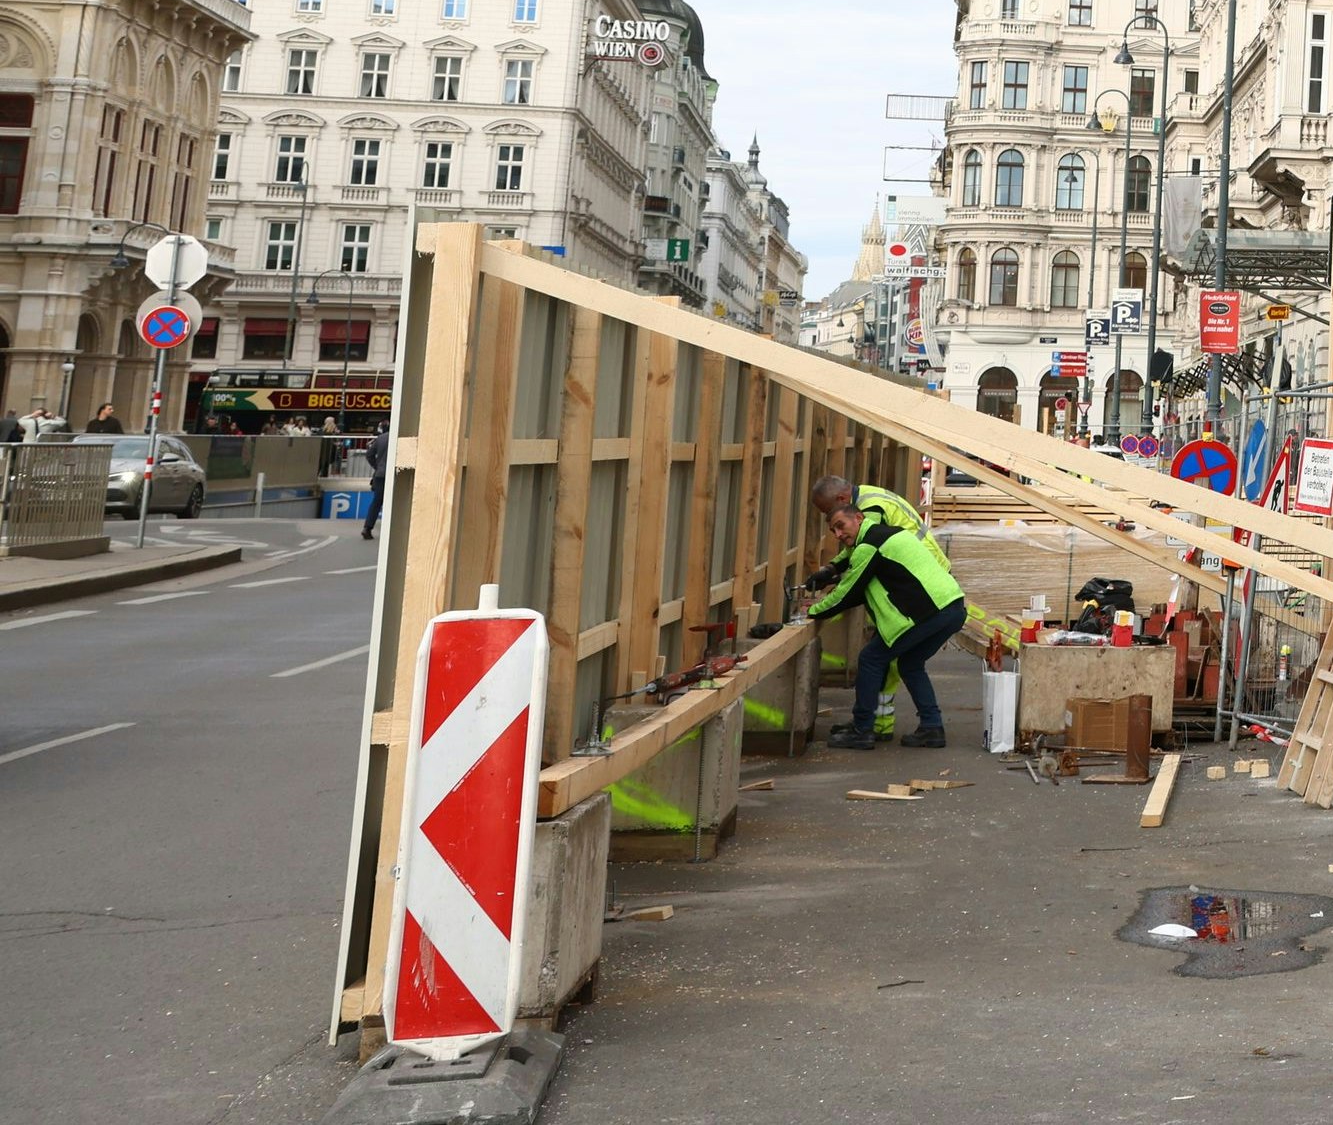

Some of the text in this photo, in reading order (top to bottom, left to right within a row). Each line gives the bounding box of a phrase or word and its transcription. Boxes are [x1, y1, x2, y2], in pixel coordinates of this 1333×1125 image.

[595, 15, 670, 41] CASINO
[594, 41, 637, 58] WIEN
[1200, 557, 1221, 567] ang
